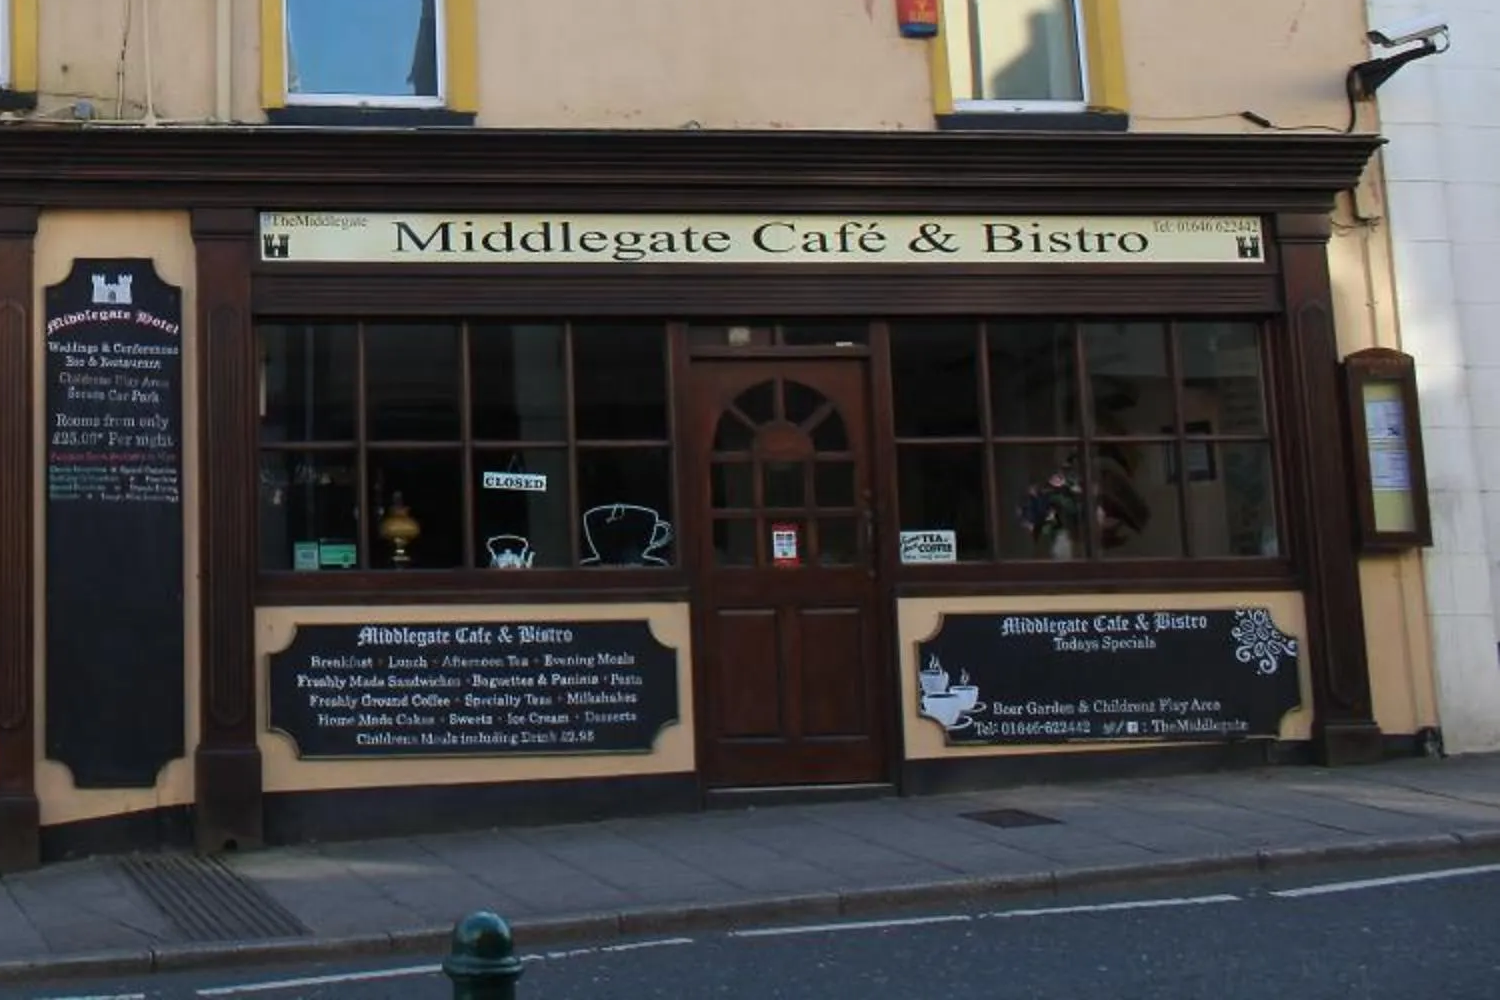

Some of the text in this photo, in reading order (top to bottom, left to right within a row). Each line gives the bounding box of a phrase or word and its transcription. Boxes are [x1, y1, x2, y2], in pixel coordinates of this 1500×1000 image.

[391, 220, 1149, 261] Middlegate Café & Bistro
[47, 309, 132, 336] Middlegate
[56, 413, 100, 428] Rooms
[485, 476, 545, 489] CLOSED
[1001, 615, 1089, 636] Middlegate
[1135, 613, 1150, 631] &
[1154, 612, 1208, 632] Bistro
[357, 625, 451, 647] Middlegate
[497, 625, 513, 643] &
[517, 625, 573, 644] Bistro
[1053, 635, 1158, 653] Todays Specials
[388, 655, 428, 669] Lunch
[544, 653, 595, 668] Evening
[297, 674, 347, 690] Freshly
[472, 673, 534, 689] Baguettes
[537, 673, 548, 686] &
[309, 693, 358, 709] Freshly
[360, 692, 409, 707] Ground
[411, 693, 451, 707] Coffee
[566, 690, 638, 705] Milkshakes
[993, 701, 1022, 715] Beer
[1026, 701, 1075, 715] Garden
[1078, 700, 1090, 713] &
[449, 712, 493, 726] Sweets
[507, 712, 525, 725] Ice
